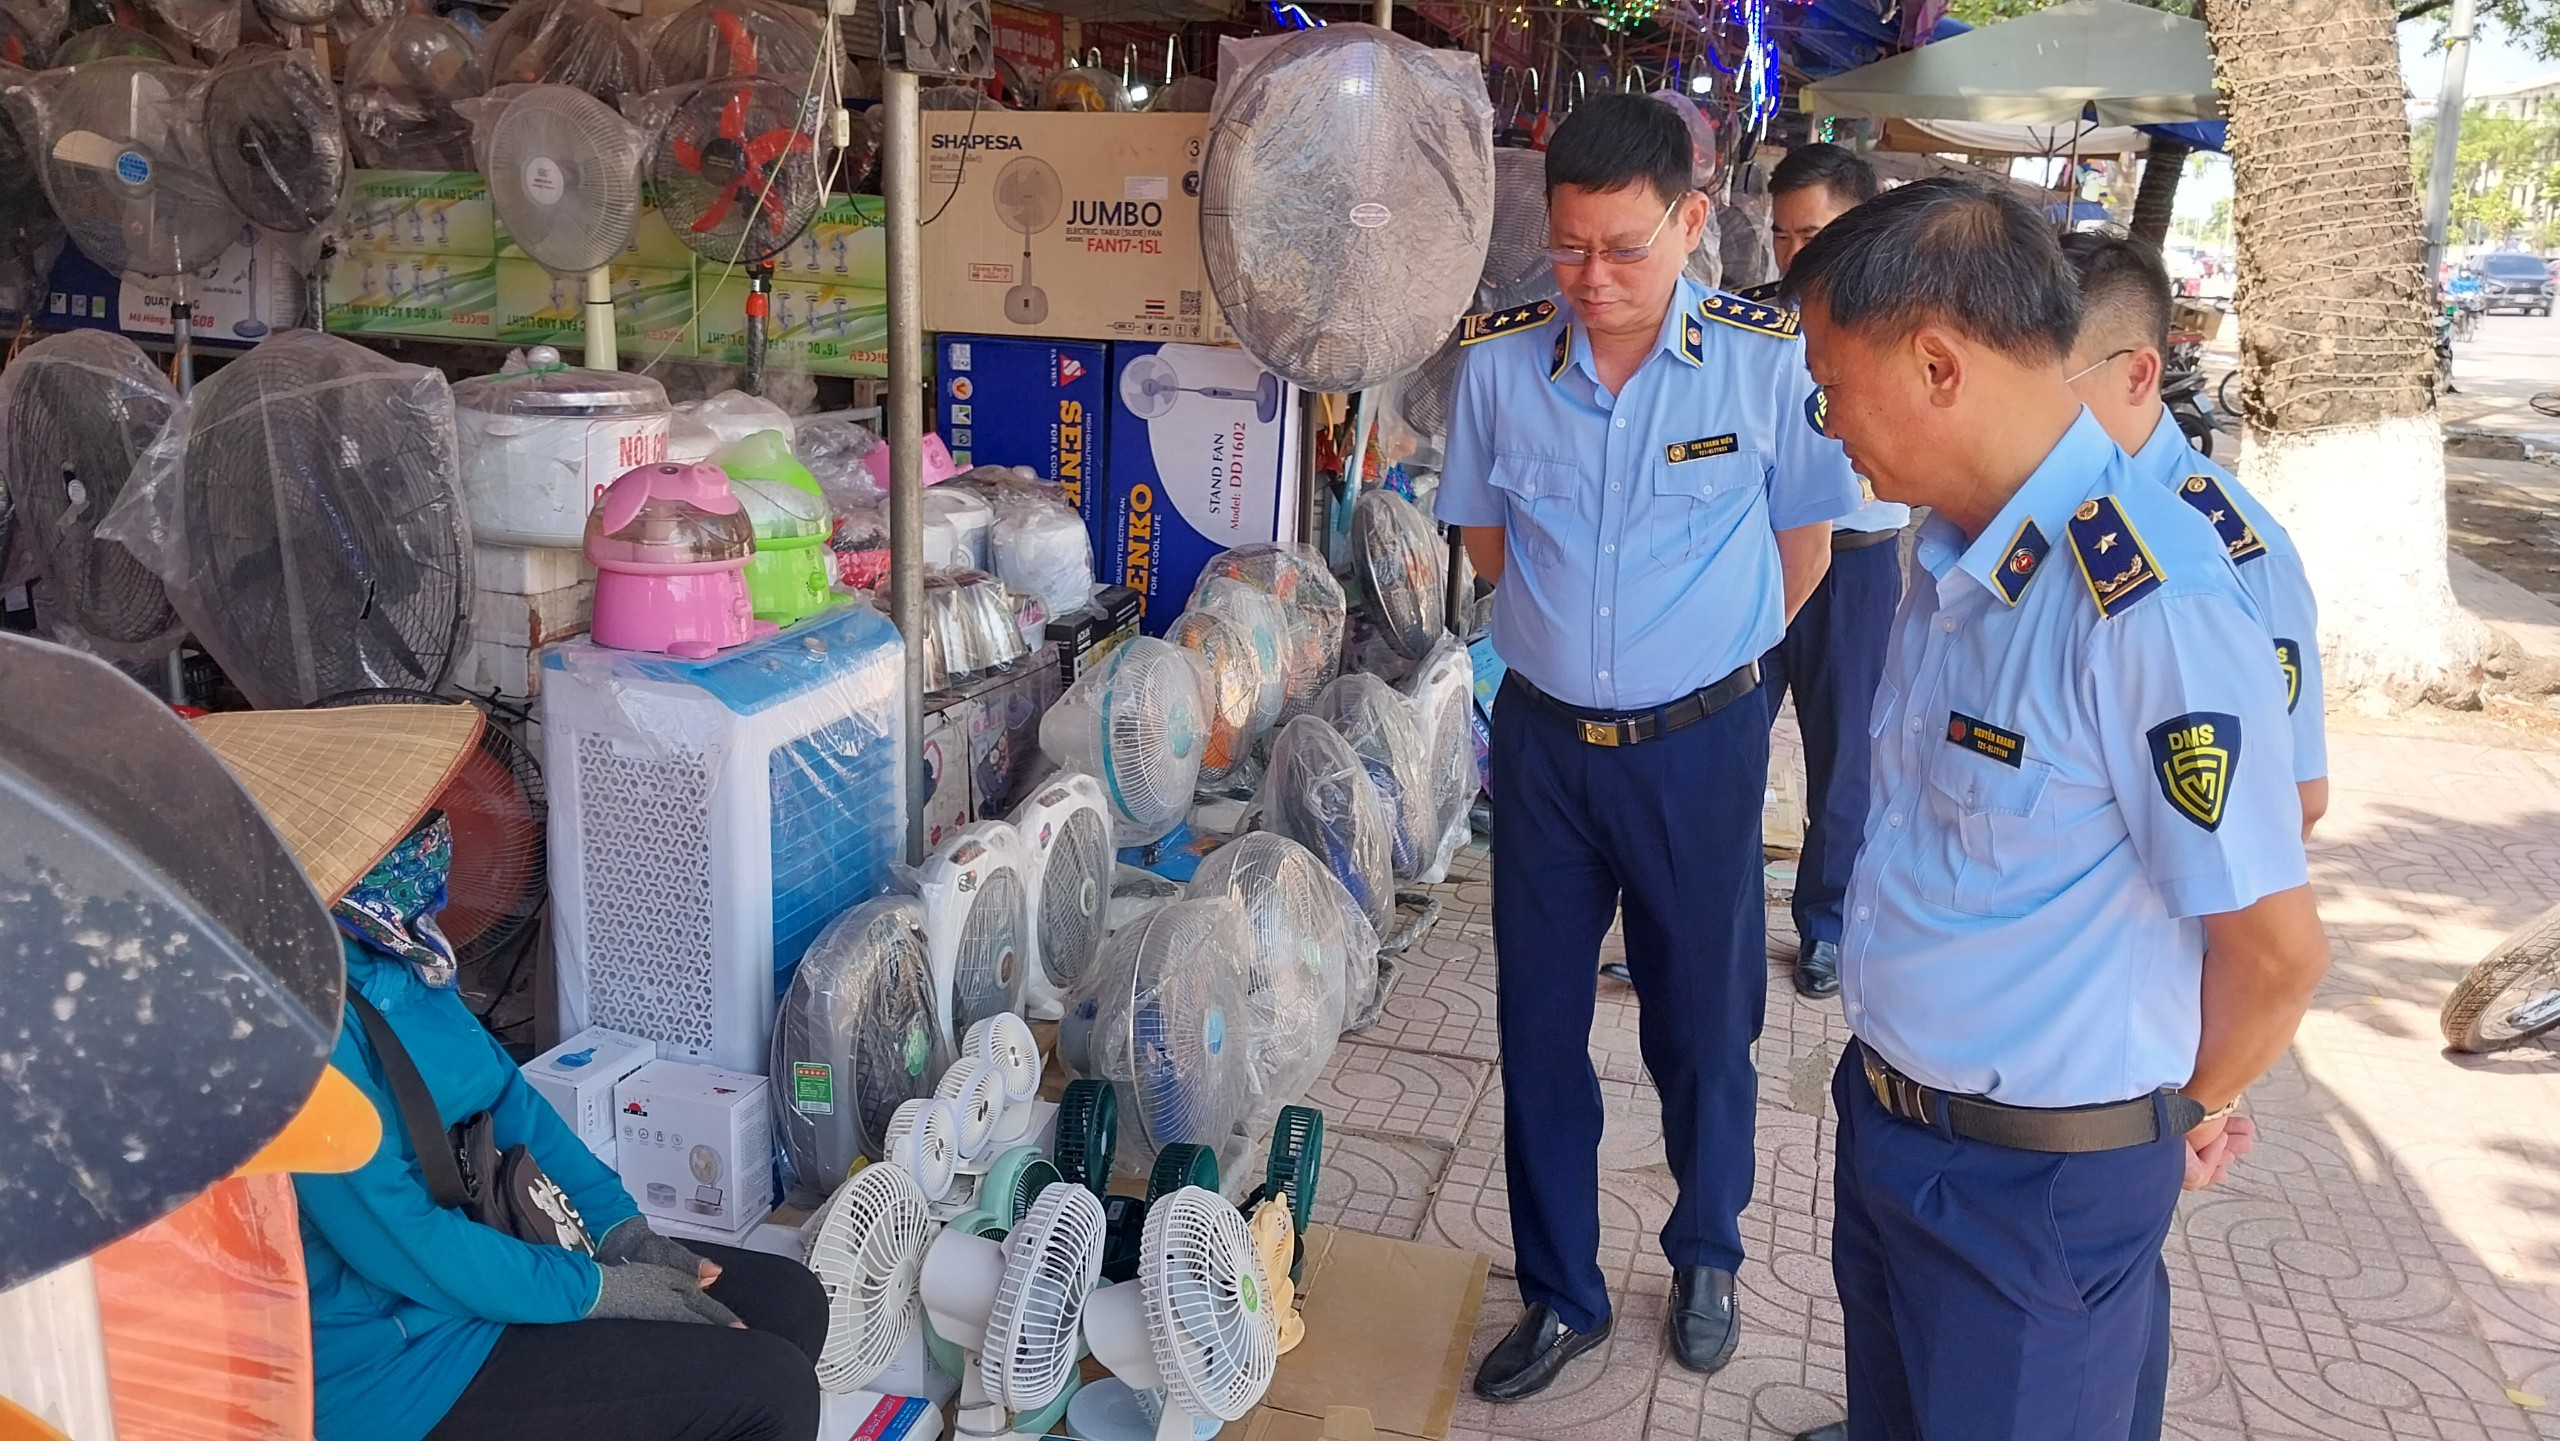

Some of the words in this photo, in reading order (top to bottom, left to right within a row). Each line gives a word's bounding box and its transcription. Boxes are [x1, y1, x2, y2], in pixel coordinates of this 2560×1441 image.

[931, 134, 1023, 150] SHAPESA
[1189, 140, 1200, 157] 3
[417, 188, 436, 199] FAN
[438, 189, 456, 200] AND
[458, 189, 485, 201] LIGHT
[839, 214, 858, 226] AND
[862, 216, 886, 228] LIGH
[1066, 200, 1162, 227] JUMBO
[1066, 227, 1098, 236] ELECTRIC
[1101, 228, 1120, 236] TABLE
[1147, 229, 1163, 237] FAN
[1087, 238, 1162, 254] FAN17-1SL
[372, 306, 389, 317] FAN
[389, 307, 402, 318] AC
[506, 314, 535, 328] LIGHT
[537, 316, 556, 329] AND
[557, 318, 577, 331] FAN
[808, 341, 820, 353] DC
[822, 343, 839, 356] 16"
[1050, 423, 1058, 443] FOR
[620, 425, 649, 467] NỒI
[1050, 445, 1058, 453] A
[1212, 433, 1225, 462] FAN
[1230, 421, 1246, 488] DD1602
[1060, 400, 1082, 510] SENK
[1084, 466, 1092, 503] ELECTRIC
[1209, 466, 1223, 515] STAND
[1230, 493, 1241, 531] Model:
[1117, 514, 1125, 552] ELECTRIC
[1153, 514, 1161, 536] LIFE
[1152, 538, 1160, 565] COOL
[1115, 550, 1124, 585] QUALITY
[1151, 566, 1158, 574] A
[1150, 577, 1158, 596] FOR
[1995, 734, 2016, 750] KHANH
[2168, 724, 2215, 751] DMS
